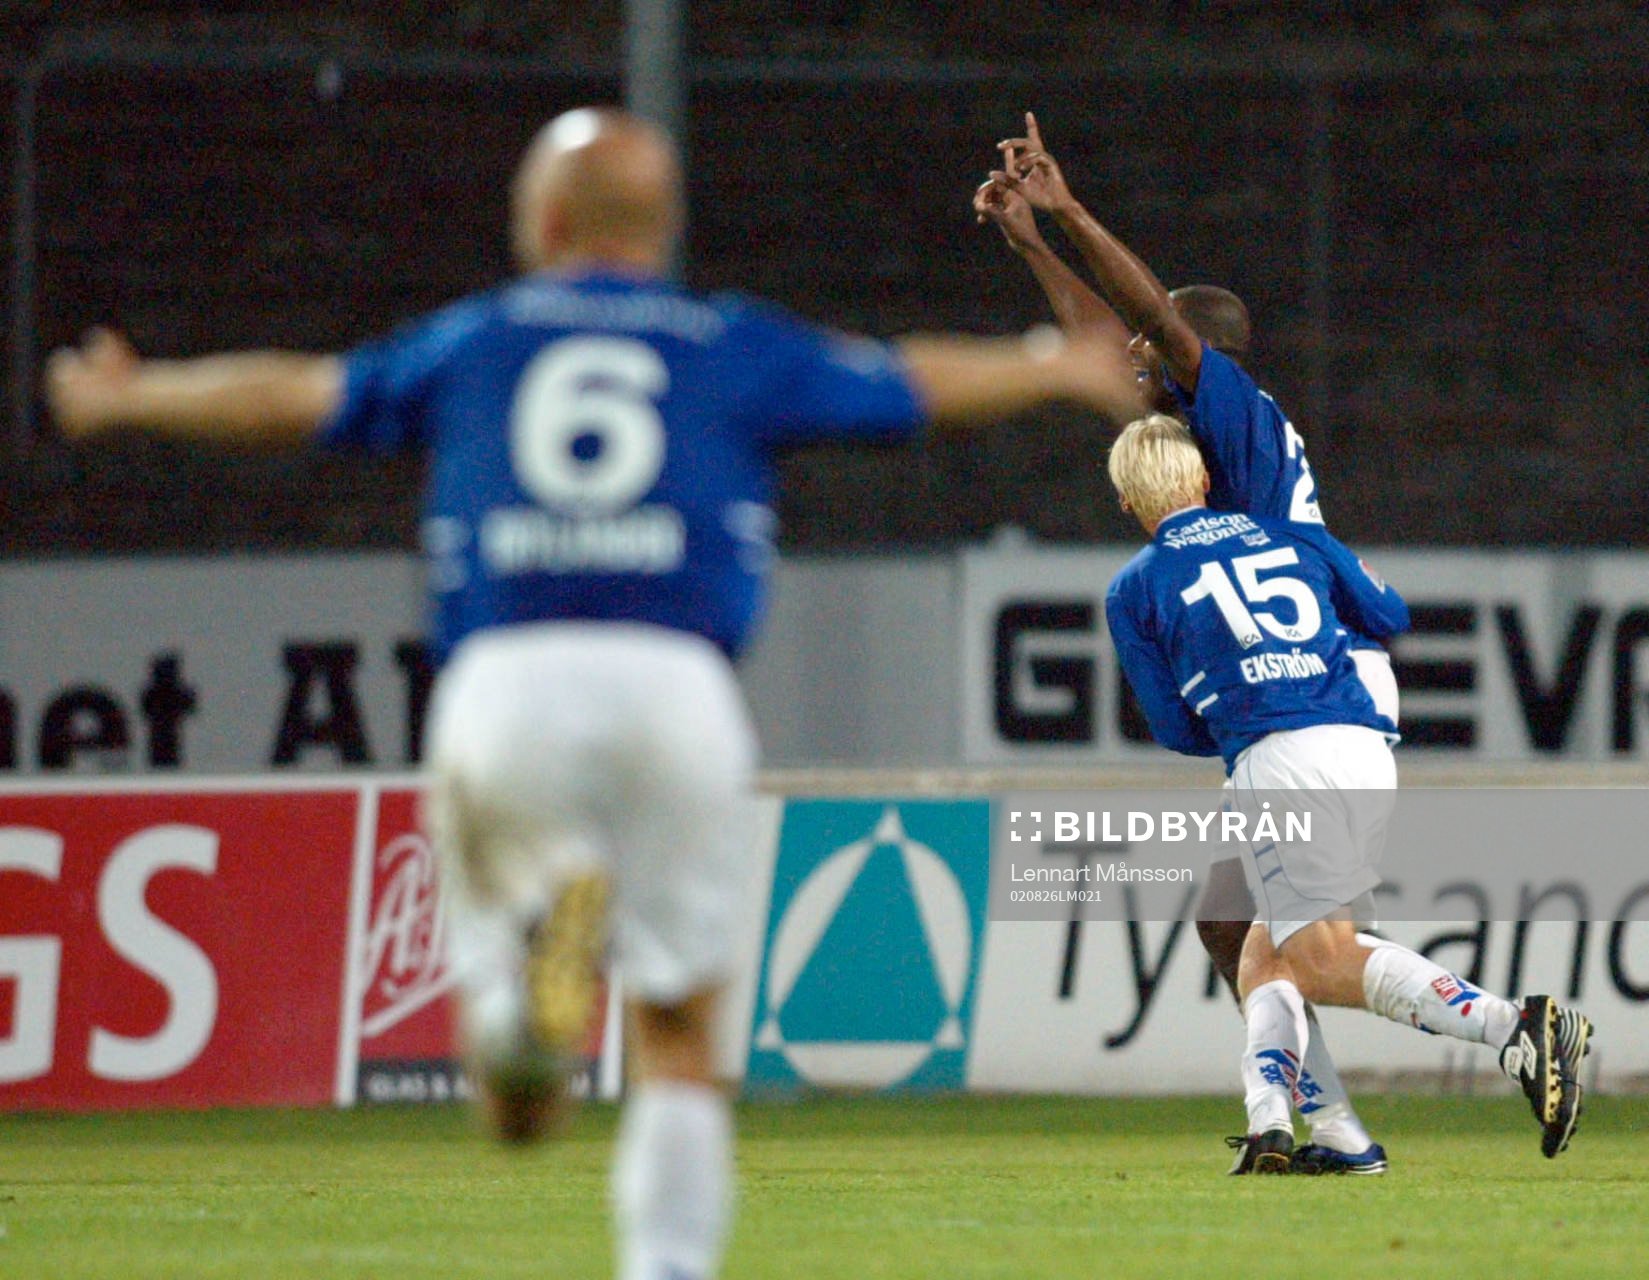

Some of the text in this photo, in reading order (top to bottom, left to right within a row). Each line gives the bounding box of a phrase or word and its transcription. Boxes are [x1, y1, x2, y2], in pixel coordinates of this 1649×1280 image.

[511, 333, 671, 512] 6
[1164, 513, 1251, 539] Carlson
[1180, 547, 1322, 650] 15
[1240, 647, 1329, 684] EKSTRÖM
